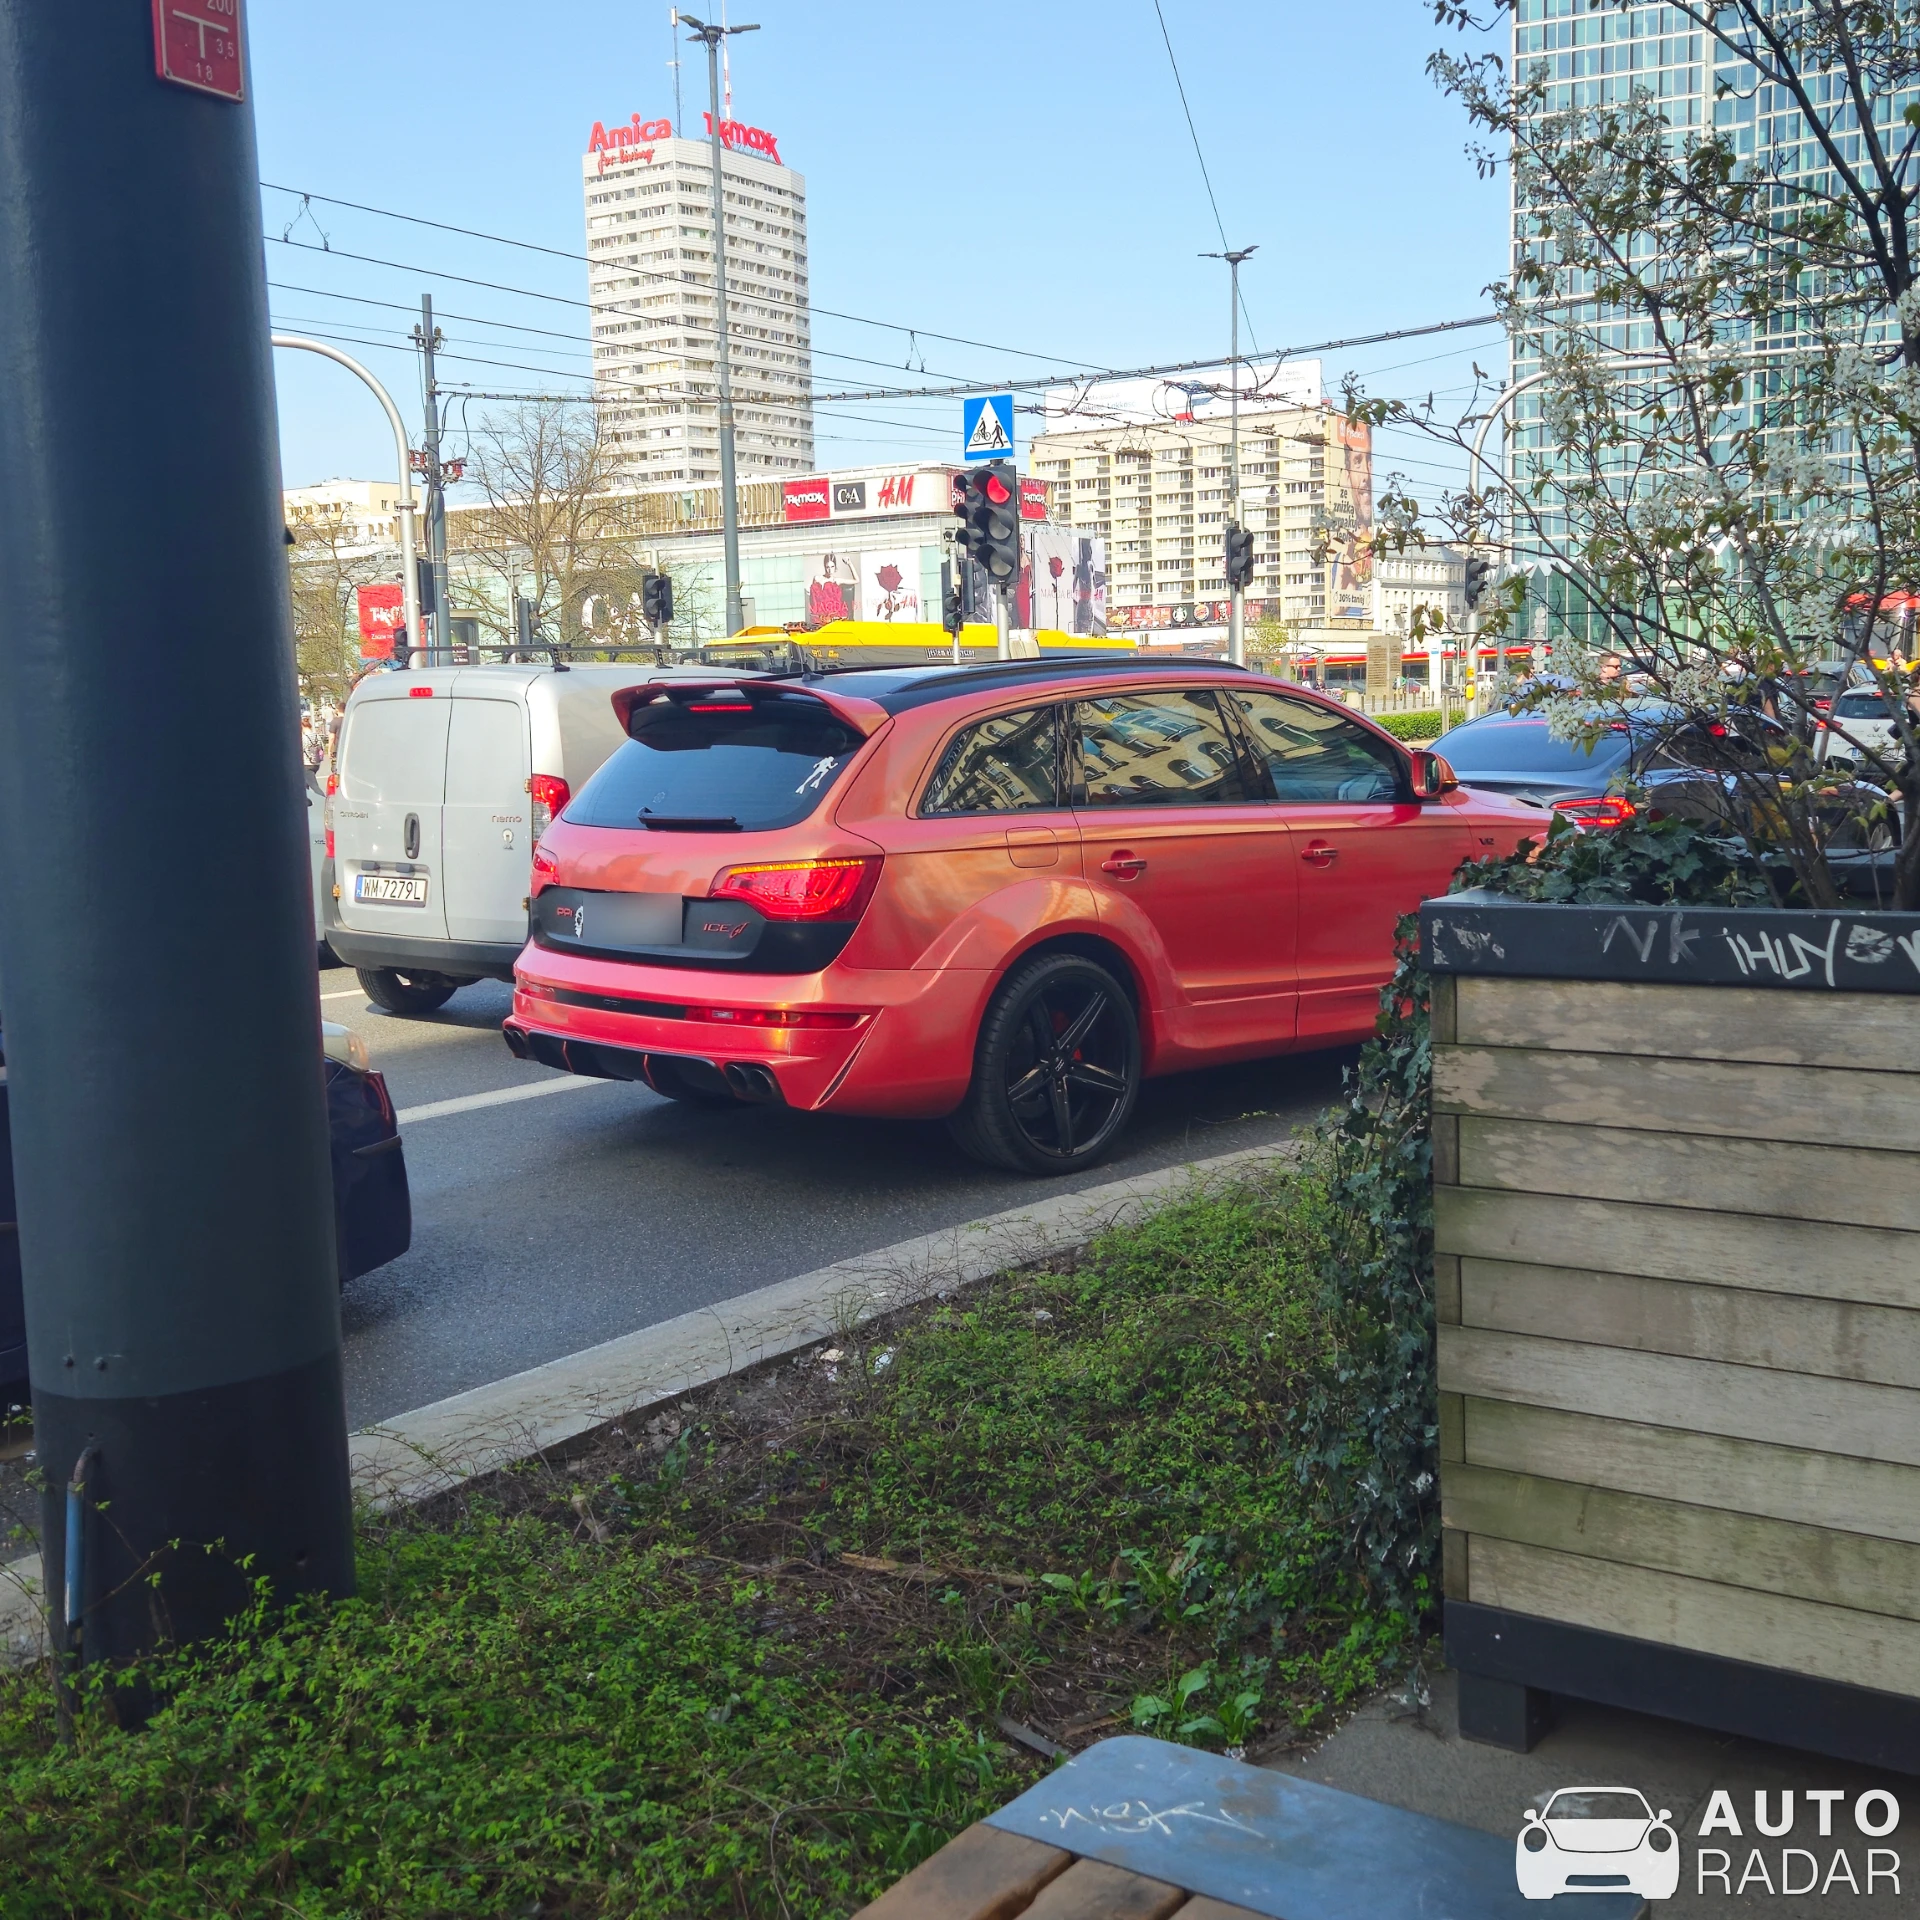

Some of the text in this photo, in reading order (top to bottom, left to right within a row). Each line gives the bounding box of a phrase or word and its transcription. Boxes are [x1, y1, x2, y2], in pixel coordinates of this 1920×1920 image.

[588, 112, 672, 153] Amica
[837, 487, 862, 505] C&A
[877, 474, 915, 509] H&M
[363, 878, 421, 900] WM 7279L
